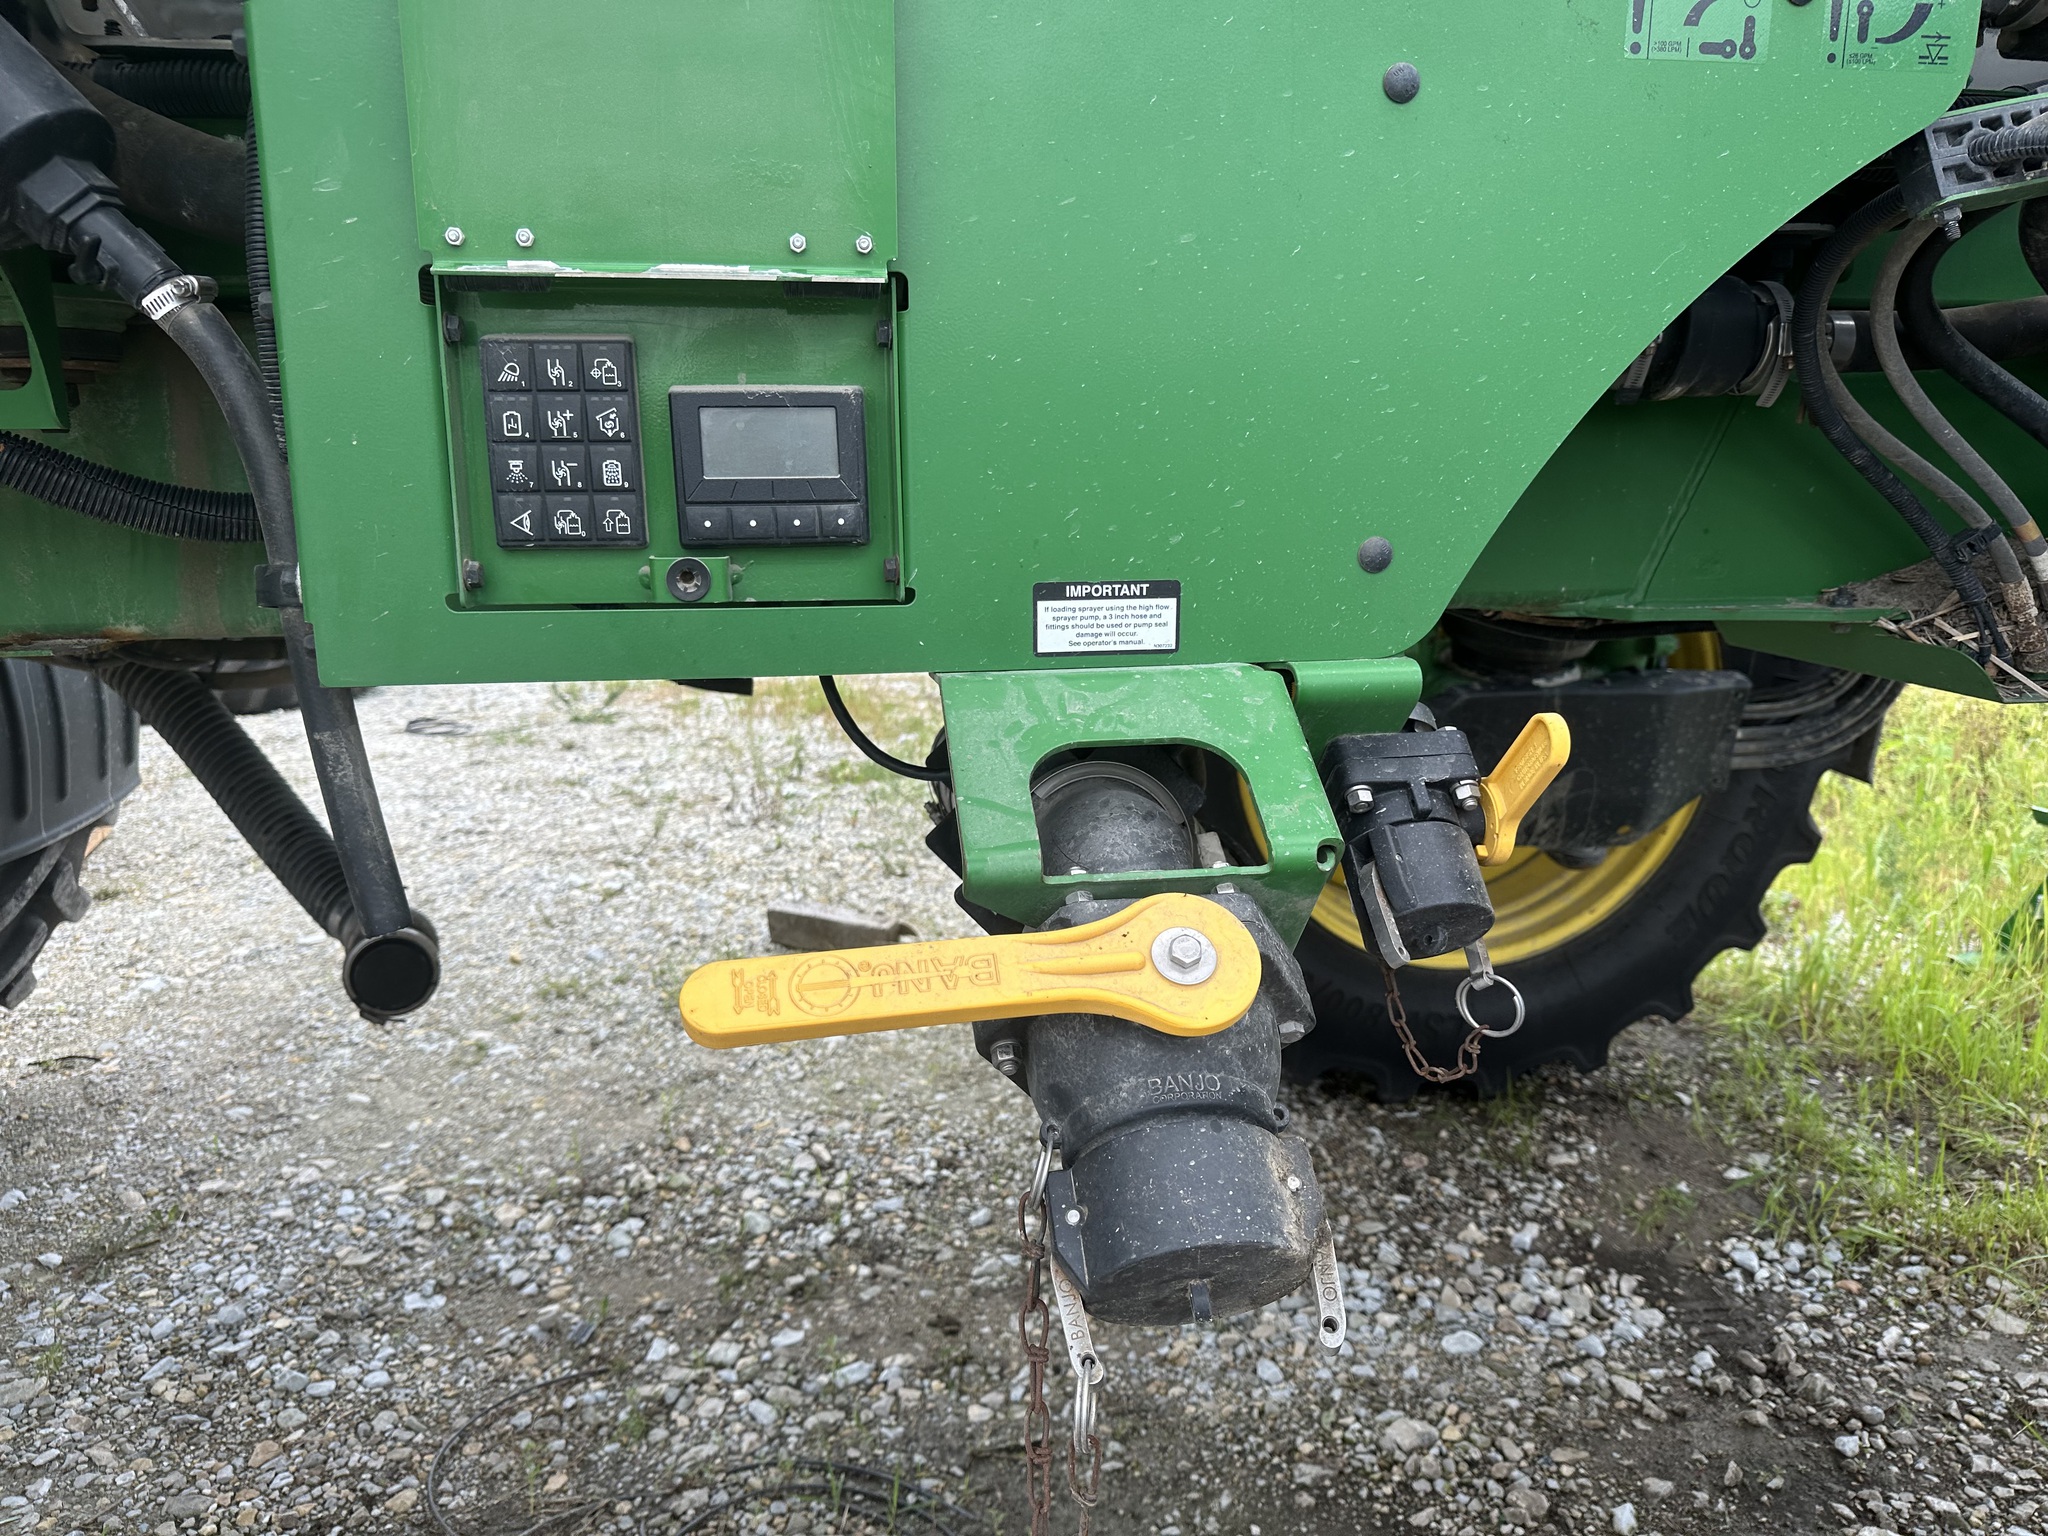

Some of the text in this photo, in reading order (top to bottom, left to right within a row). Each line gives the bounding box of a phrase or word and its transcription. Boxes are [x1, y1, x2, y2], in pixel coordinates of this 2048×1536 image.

[1066, 584, 1150, 598] IMPORTANT
[1082, 639, 1117, 647] operator's
[1148, 1074, 1220, 1096] BANJO
[1152, 1092, 1222, 1104] CORPORATION
[1059, 1279, 1084, 1340] BANJO
